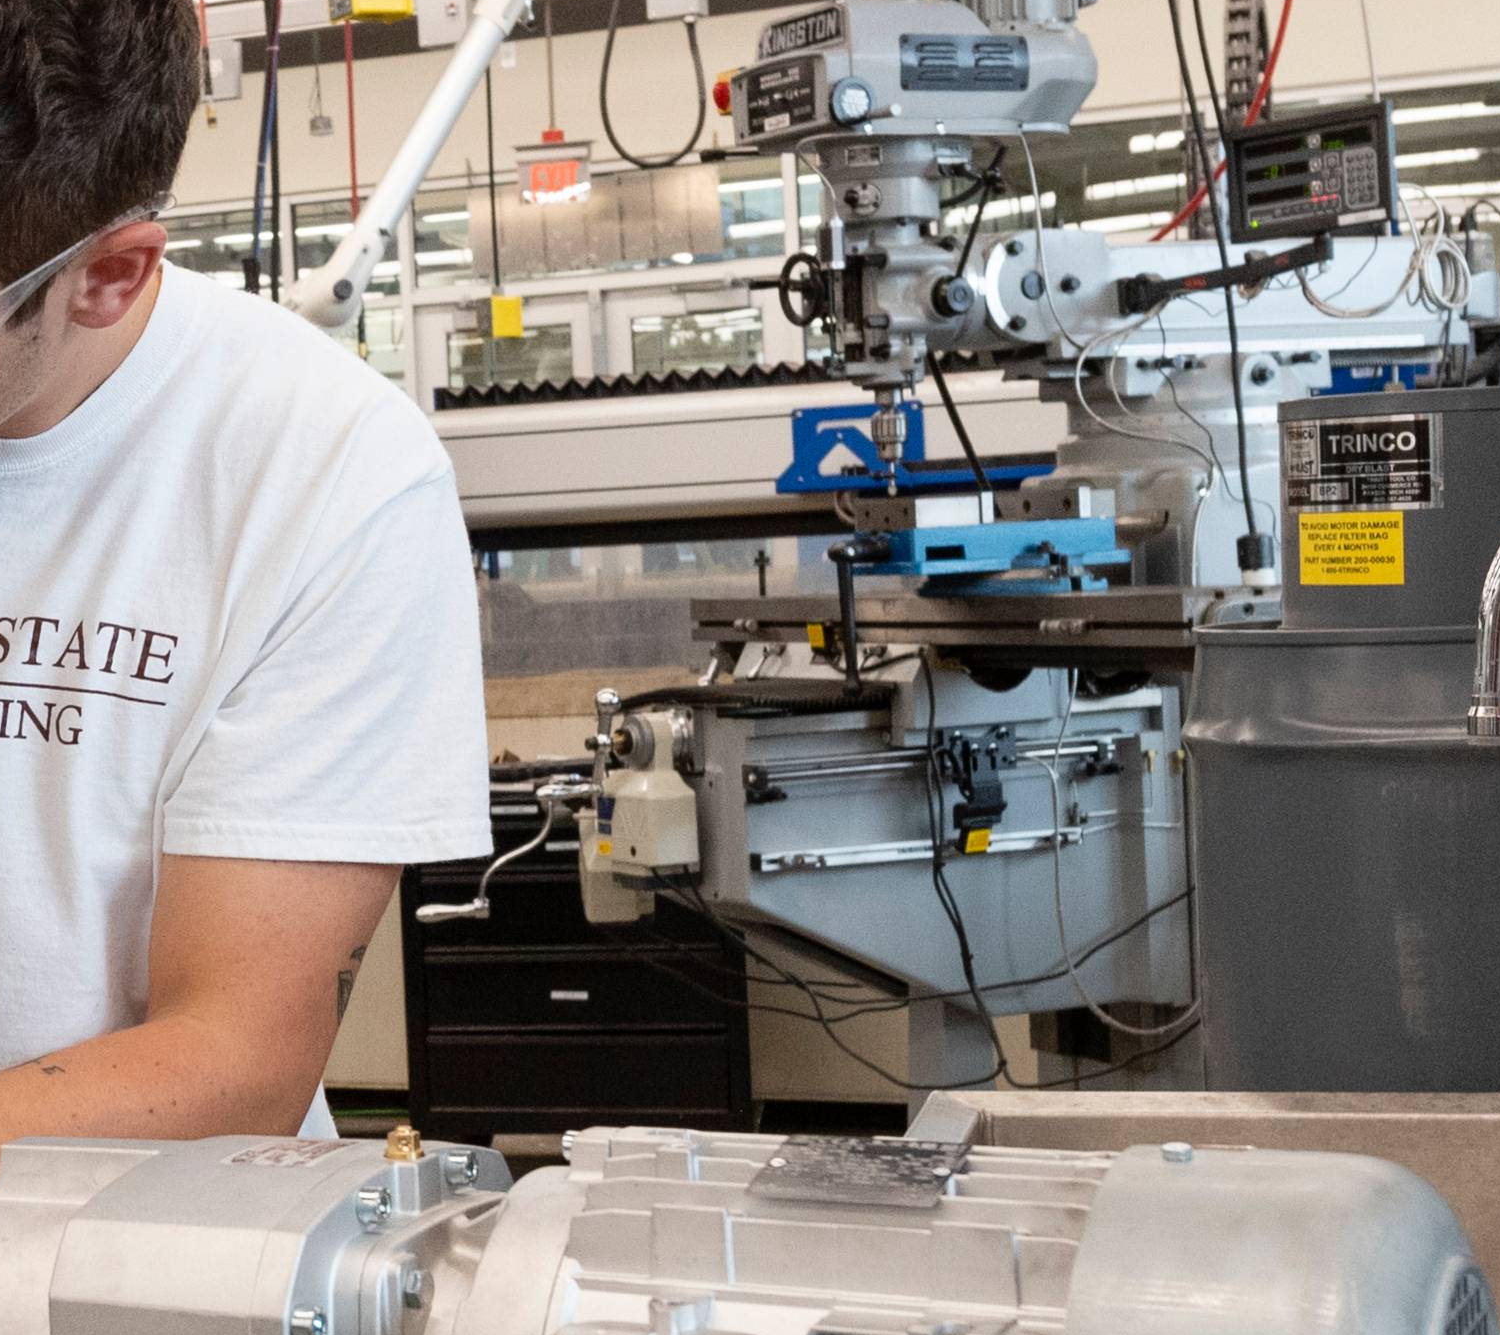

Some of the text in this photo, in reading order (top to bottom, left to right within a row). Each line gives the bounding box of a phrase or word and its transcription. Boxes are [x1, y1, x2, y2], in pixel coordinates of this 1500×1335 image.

[760, 10, 838, 59] KINGSTON
[530, 159, 580, 193] EXIT
[1328, 431, 1417, 455] TRINCO
[1330, 521, 1359, 530] MOTOR
[1360, 520, 1400, 529] DAMAGE
[1307, 531, 1389, 541] REPLACE FILTER BAG
[1313, 543, 1335, 552] EVERY
[1343, 543, 1380, 552] MONTHS
[1320, 556, 1353, 565] NUMBER
